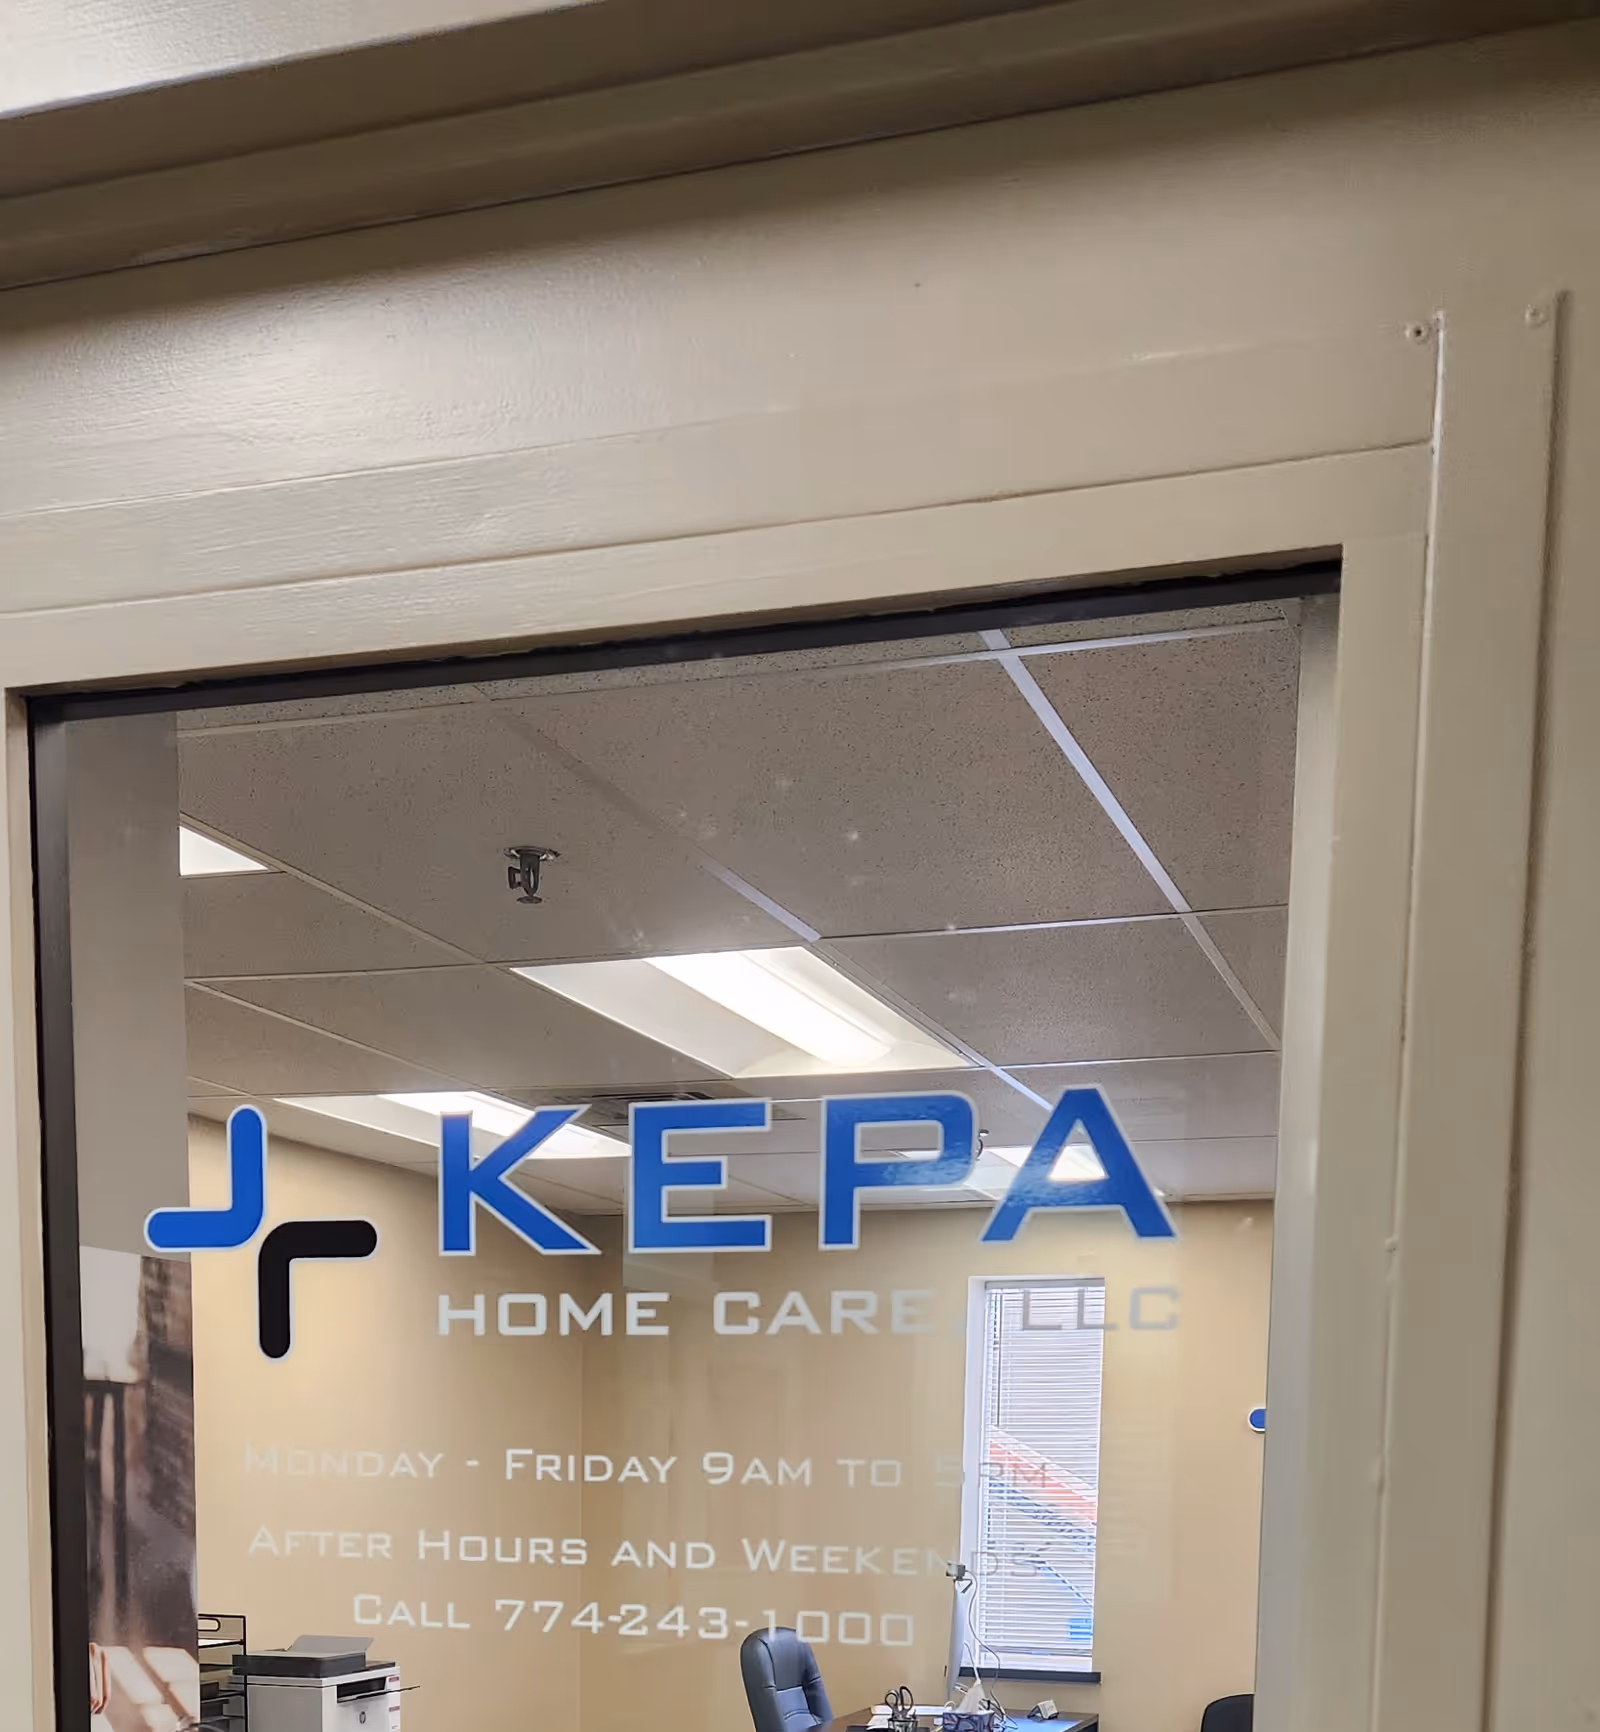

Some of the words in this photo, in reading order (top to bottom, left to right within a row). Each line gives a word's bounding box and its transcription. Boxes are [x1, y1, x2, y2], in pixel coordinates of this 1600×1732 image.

[438, 1084, 1179, 1256] KEPA
[438, 1292, 670, 1336] HOME
[1022, 1286, 1180, 1331] LLC
[244, 1441, 444, 1480] MONDAY
[505, 1448, 678, 1484] FRIDAY
[702, 1452, 812, 1486] 9AM
[837, 1458, 902, 1488] TO
[248, 1525, 393, 1559] AFTER
[417, 1530, 588, 1566] HOURS
[610, 1540, 716, 1570] AND
[353, 1594, 471, 1630] CALL
[495, 1598, 914, 1647] 774-243-1000
